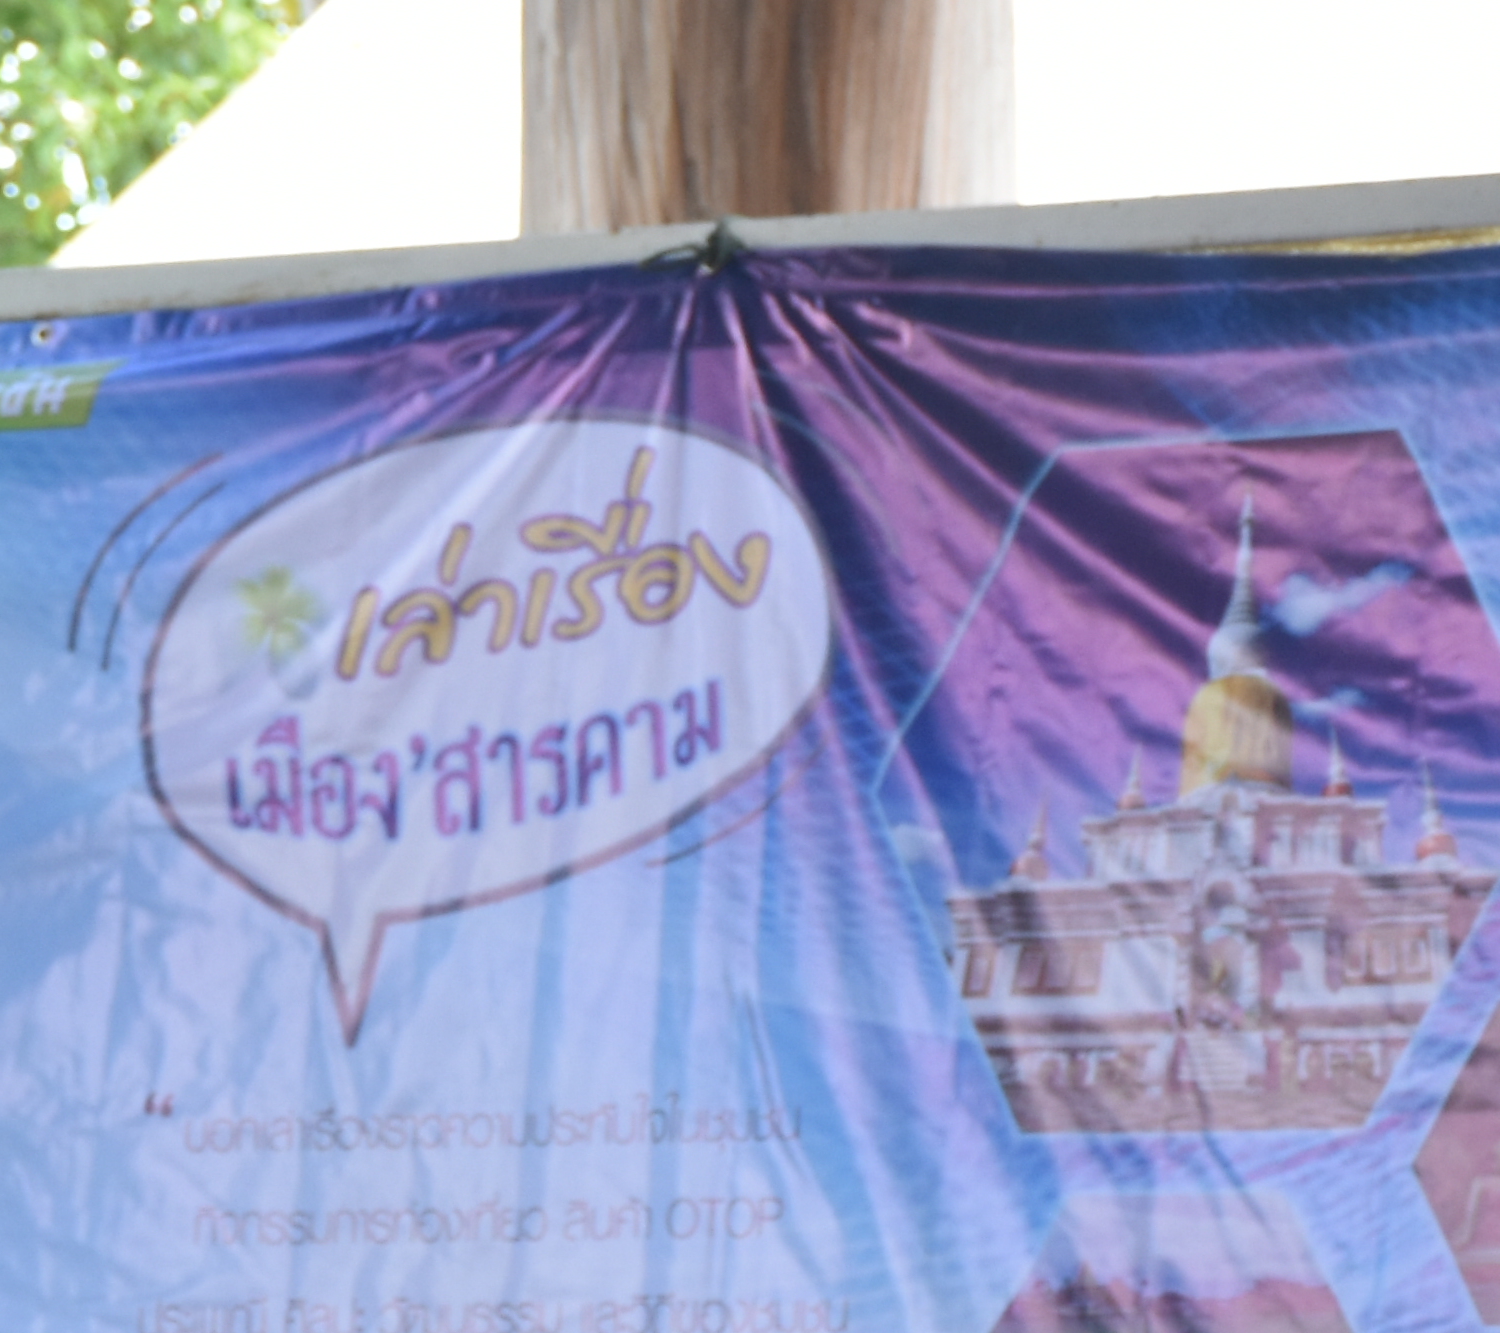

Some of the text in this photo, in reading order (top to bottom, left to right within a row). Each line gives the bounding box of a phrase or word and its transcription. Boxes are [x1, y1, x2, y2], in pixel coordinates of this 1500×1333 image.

[336, 446, 772, 681] เล่าเรื่อง
[665, 1197, 787, 1240] OTOP
